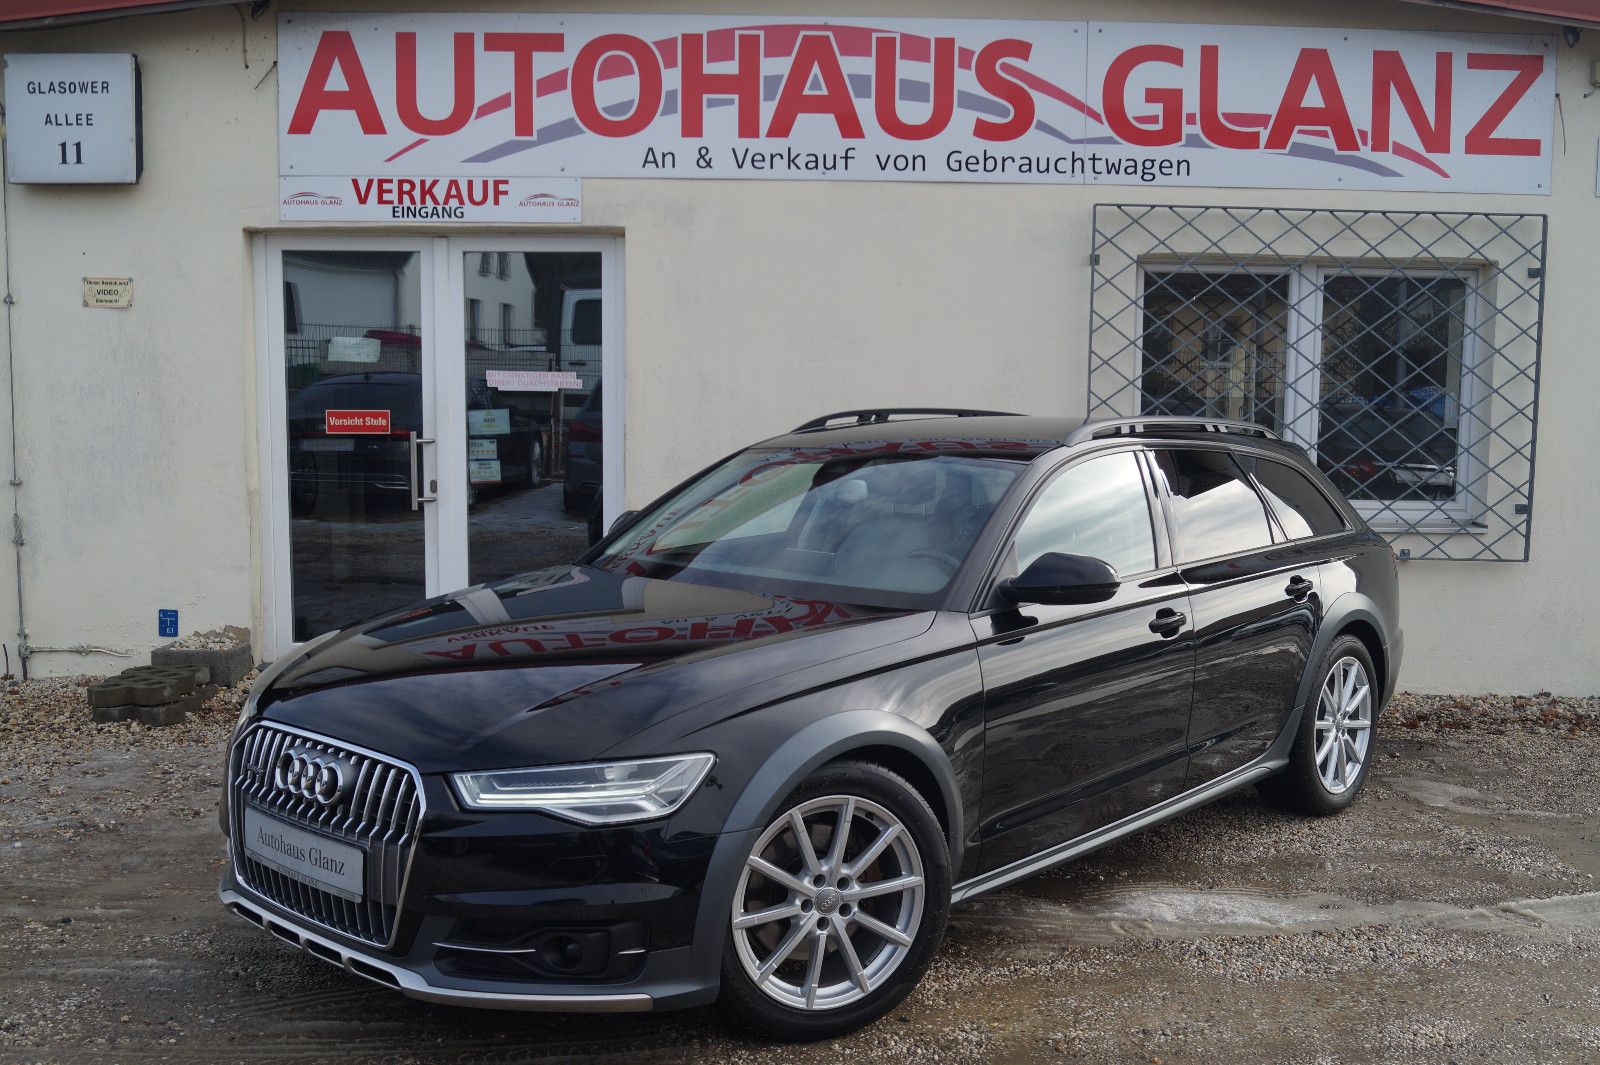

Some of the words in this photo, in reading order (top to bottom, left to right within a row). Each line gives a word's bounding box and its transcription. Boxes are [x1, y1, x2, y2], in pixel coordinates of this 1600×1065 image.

[26, 81, 110, 95] GLASOWER
[286, 30, 1034, 142] AUTOHAUS
[1102, 44, 1544, 157] GLANZ
[44, 113, 94, 127] ALLEE
[57, 140, 84, 166] 11
[642, 147, 676, 169] An
[696, 147, 713, 170] &
[732, 147, 856, 172] Verkauf
[875, 151, 926, 173] von
[946, 149, 1192, 181] Gebrauchtwagen
[351, 178, 510, 207] VERKAUF
[392, 205, 464, 219] EINGANG
[519, 200, 556, 208] AUTOHAUS
[328, 416, 363, 426] Vorsicht
[364, 416, 387, 426] Stufe
[256, 826, 306, 862] Autohaus
[308, 847, 346, 876] Glanz
